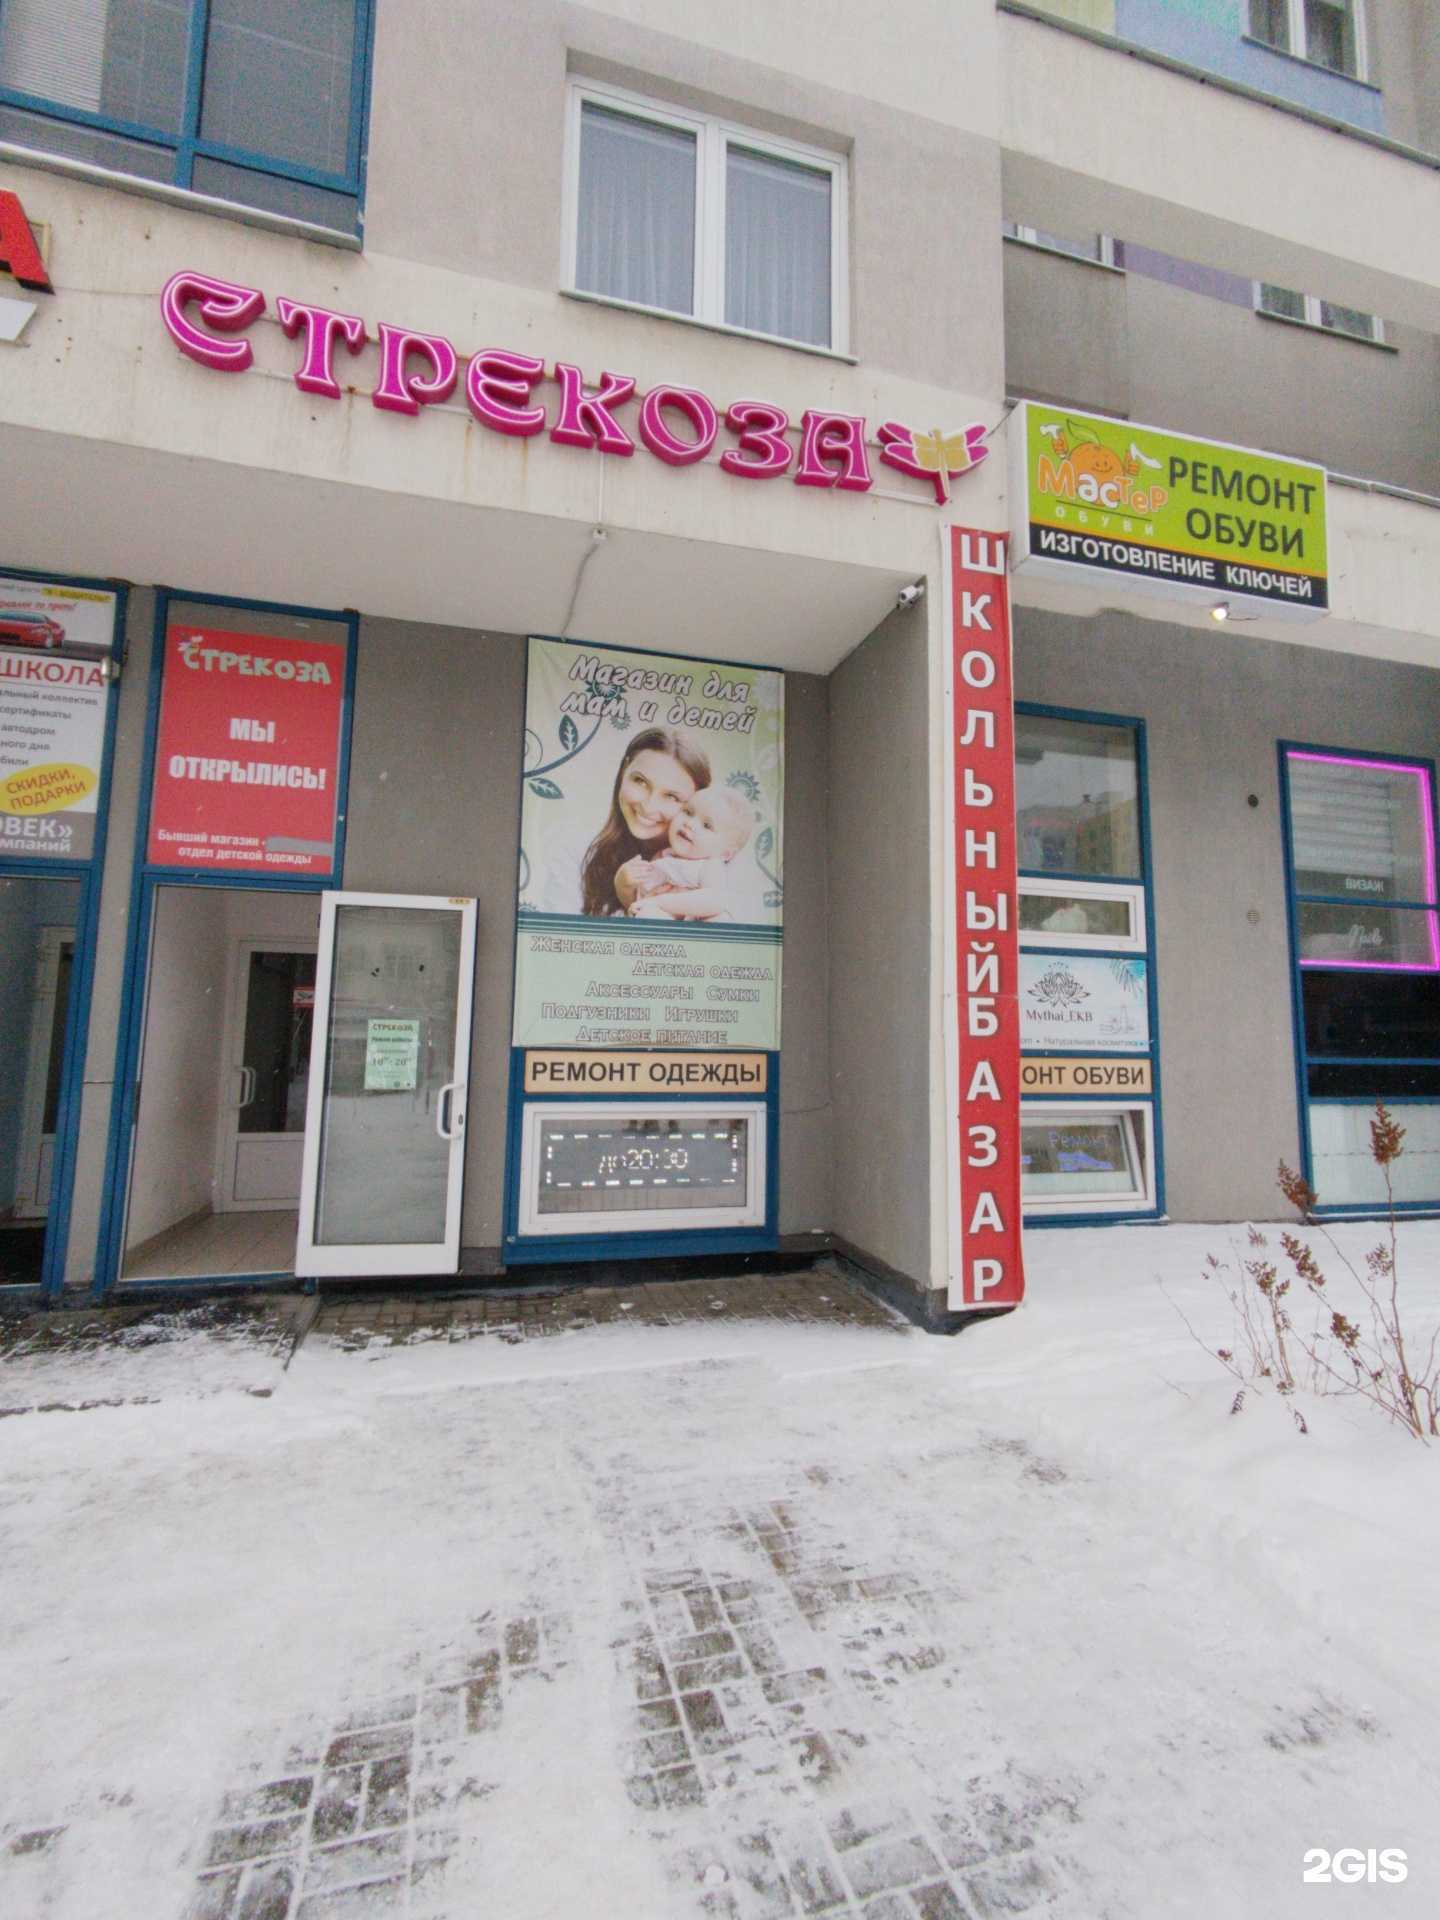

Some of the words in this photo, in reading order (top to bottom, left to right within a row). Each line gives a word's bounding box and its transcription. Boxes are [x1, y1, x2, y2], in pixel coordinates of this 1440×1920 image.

[160, 270, 874, 493] СТРЕКОЗА
[1169, 456, 1317, 514] РЕМОНТ
[1186, 508, 1304, 558] ОБУВИ
[1040, 529, 1216, 581] ИЗГОТОВЛЕНИЕ
[1226, 565, 1312, 599] КЛЮЧЕЙ
[182, 646, 331, 685] СТРЕКОЗА
[569, 654, 693, 696] Магазин
[702, 670, 750, 703] для
[229, 717, 275, 743] МЫ
[560, 691, 628, 720] мам
[638, 701, 657, 723] и
[667, 697, 758, 734] детей
[169, 755, 327, 790] ОТКРЫЛИСЬ!
[10, 781, 87, 810] ПОДАРКИ
[0, 815, 73, 839] ВЕК»
[531, 1062, 641, 1082] РЕМОНТ
[649, 1062, 761, 1086] ОДЕЖДЫ
[1021, 1066, 1066, 1086] ОНТ
[1072, 1065, 1145, 1086] ОБУВИ
